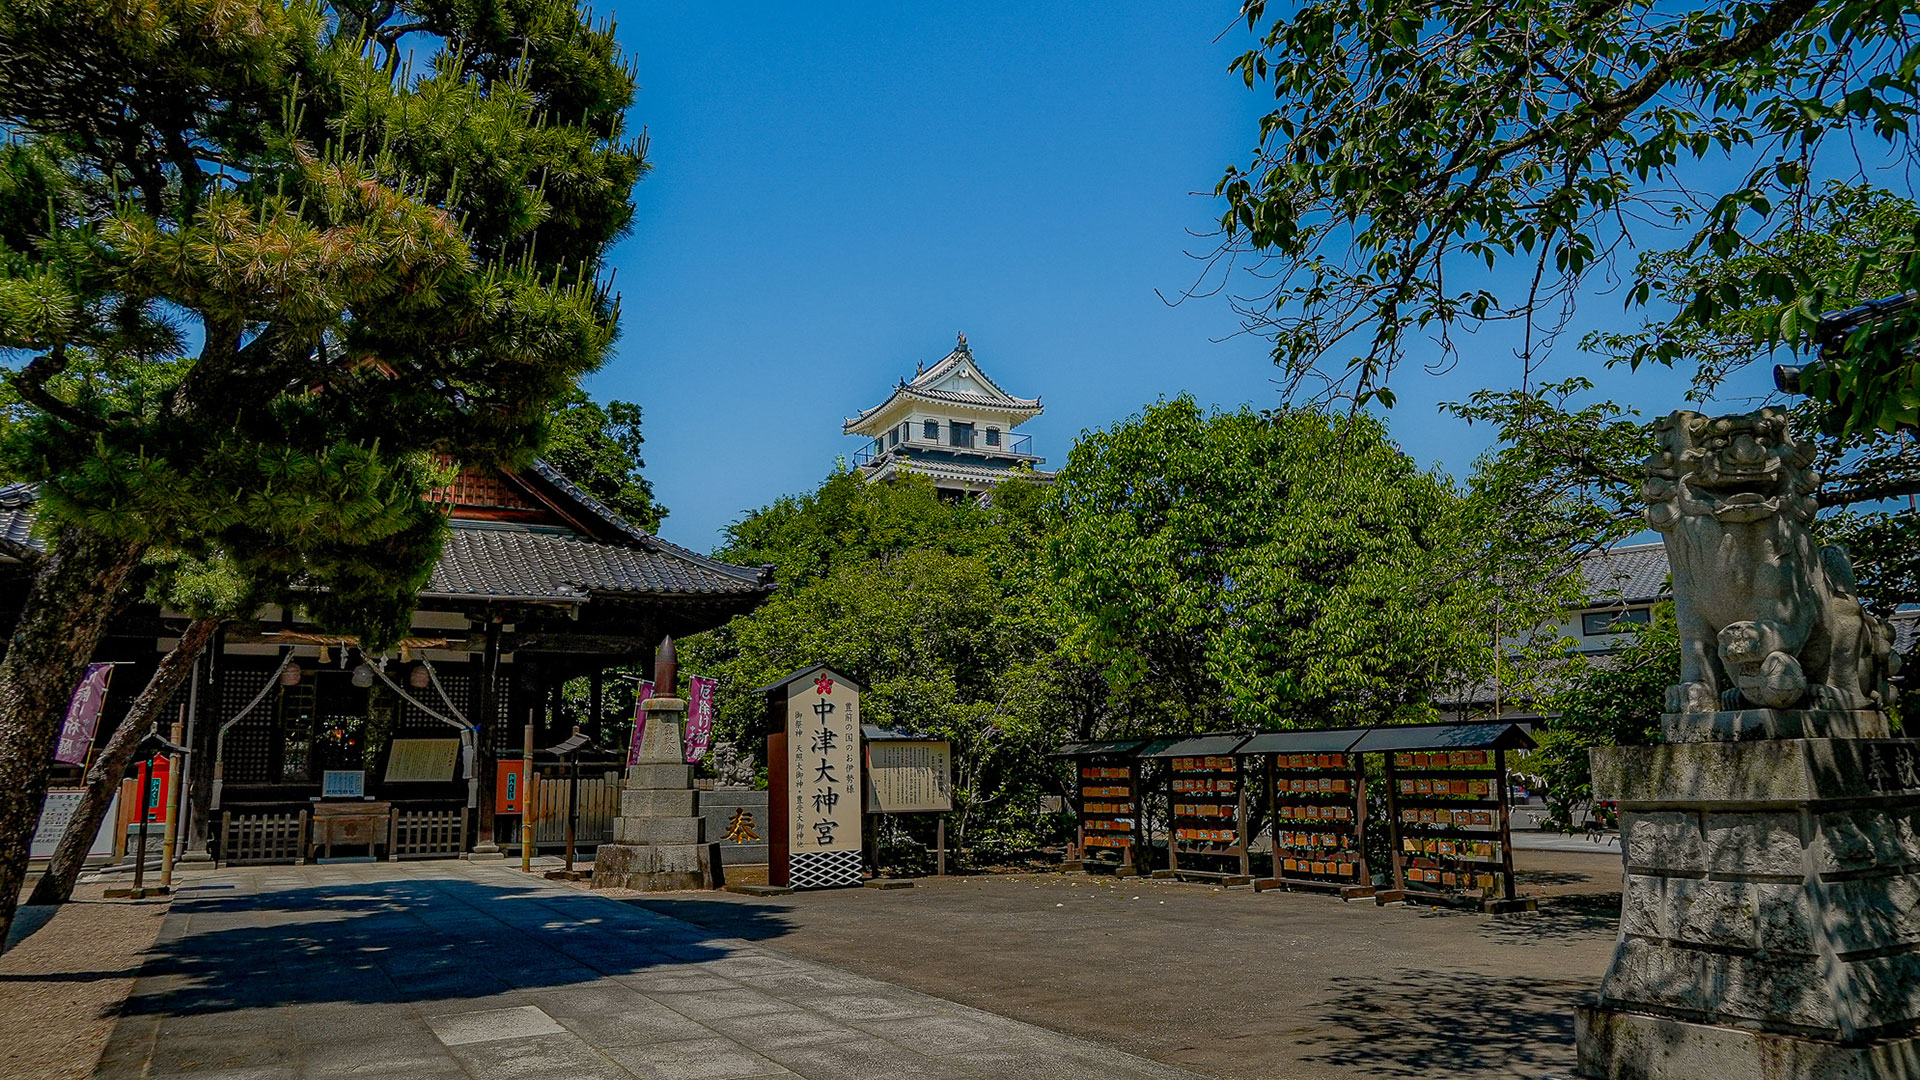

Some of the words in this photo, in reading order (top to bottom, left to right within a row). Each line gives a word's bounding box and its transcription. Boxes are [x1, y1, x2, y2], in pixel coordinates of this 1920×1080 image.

[693, 683, 713, 760] 厄除け祈願
[794, 711, 803, 737] 御祭神
[811, 698, 840, 847] 中津大神宮
[720, 807, 760, 844] 奉
